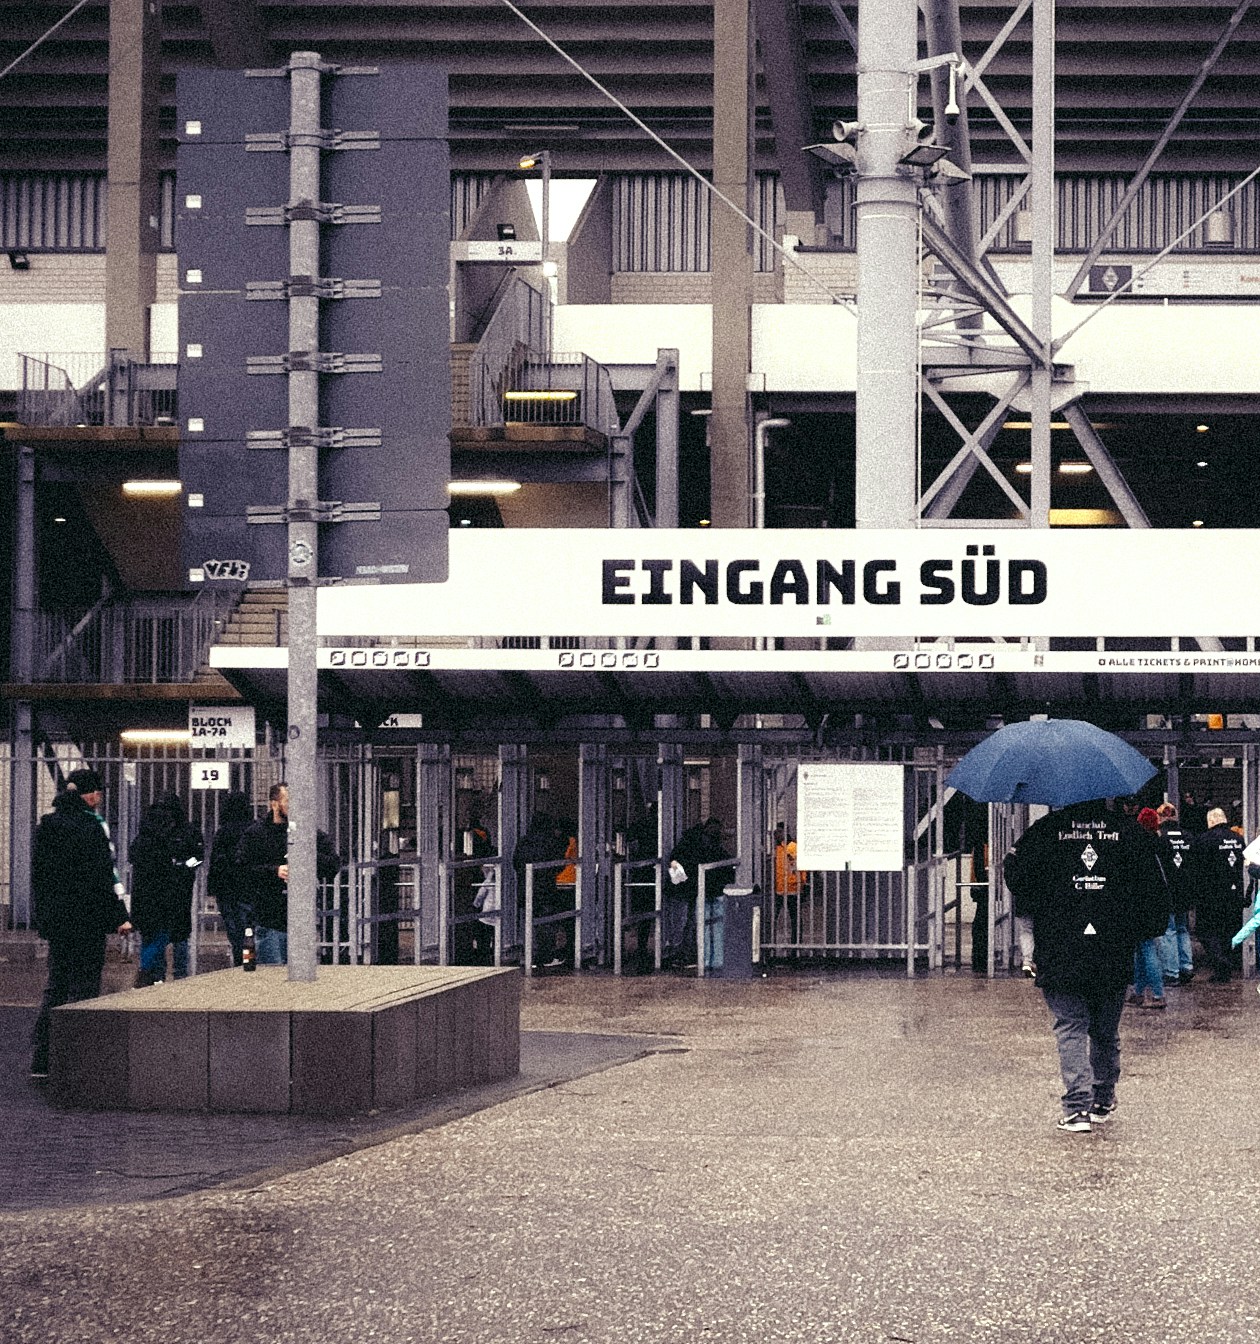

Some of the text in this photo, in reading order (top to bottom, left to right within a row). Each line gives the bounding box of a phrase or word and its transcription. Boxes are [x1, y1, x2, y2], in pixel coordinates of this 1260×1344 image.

[602, 544, 1048, 606] EINGANG SÜD
[1108, 658, 1135, 667] ALLE
[1138, 658, 1181, 667] TICKETS
[191, 717, 232, 737] BLOCK 1A-7A
[201, 769, 219, 781] 19
